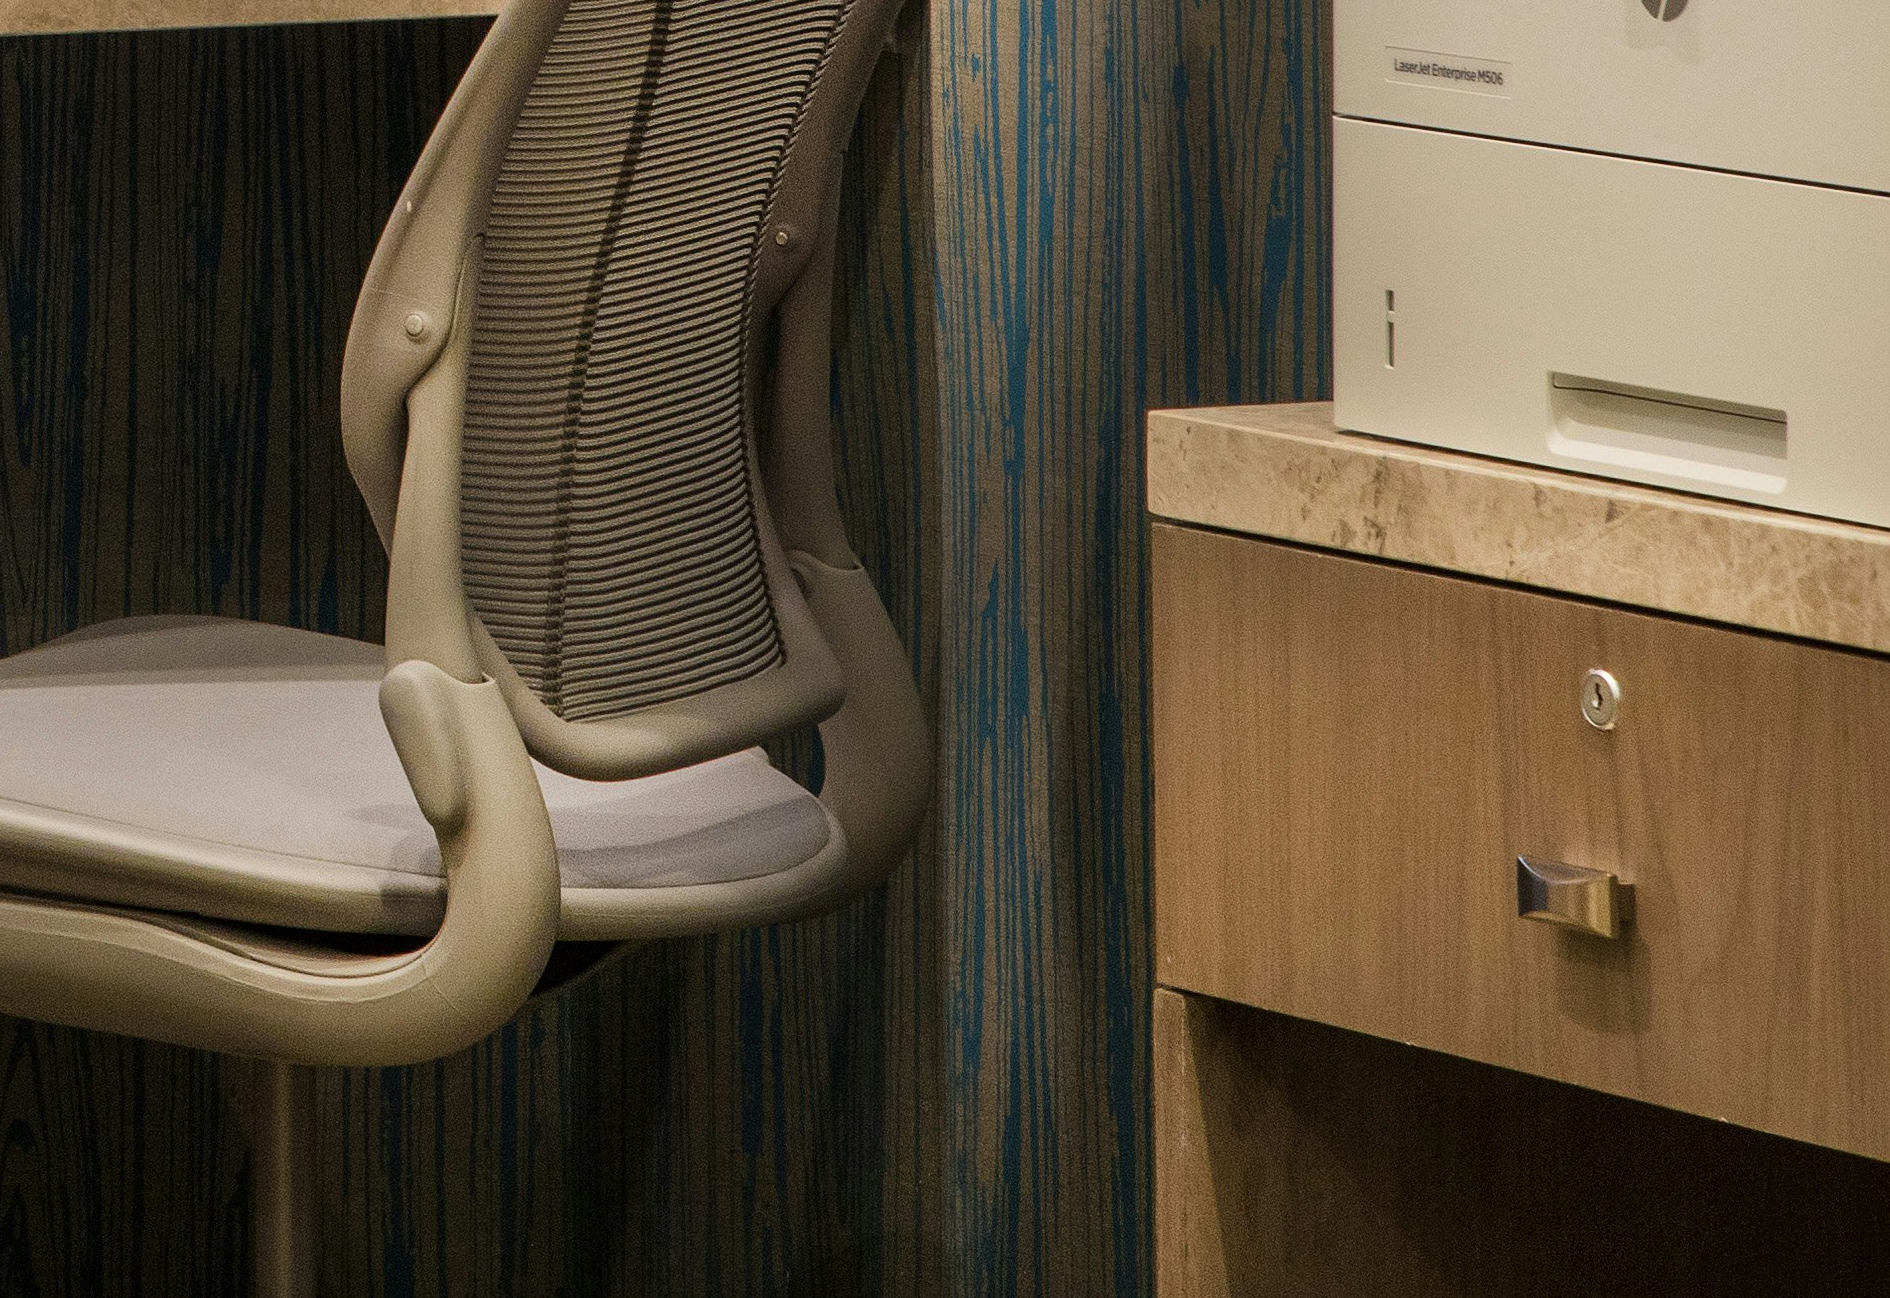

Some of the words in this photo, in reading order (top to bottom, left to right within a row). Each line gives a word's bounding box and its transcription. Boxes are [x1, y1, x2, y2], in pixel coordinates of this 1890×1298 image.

[1394, 58, 1431, 75] LaserJet
[1432, 63, 1477, 82] Enterprise
[1477, 69, 1503, 85] M506
